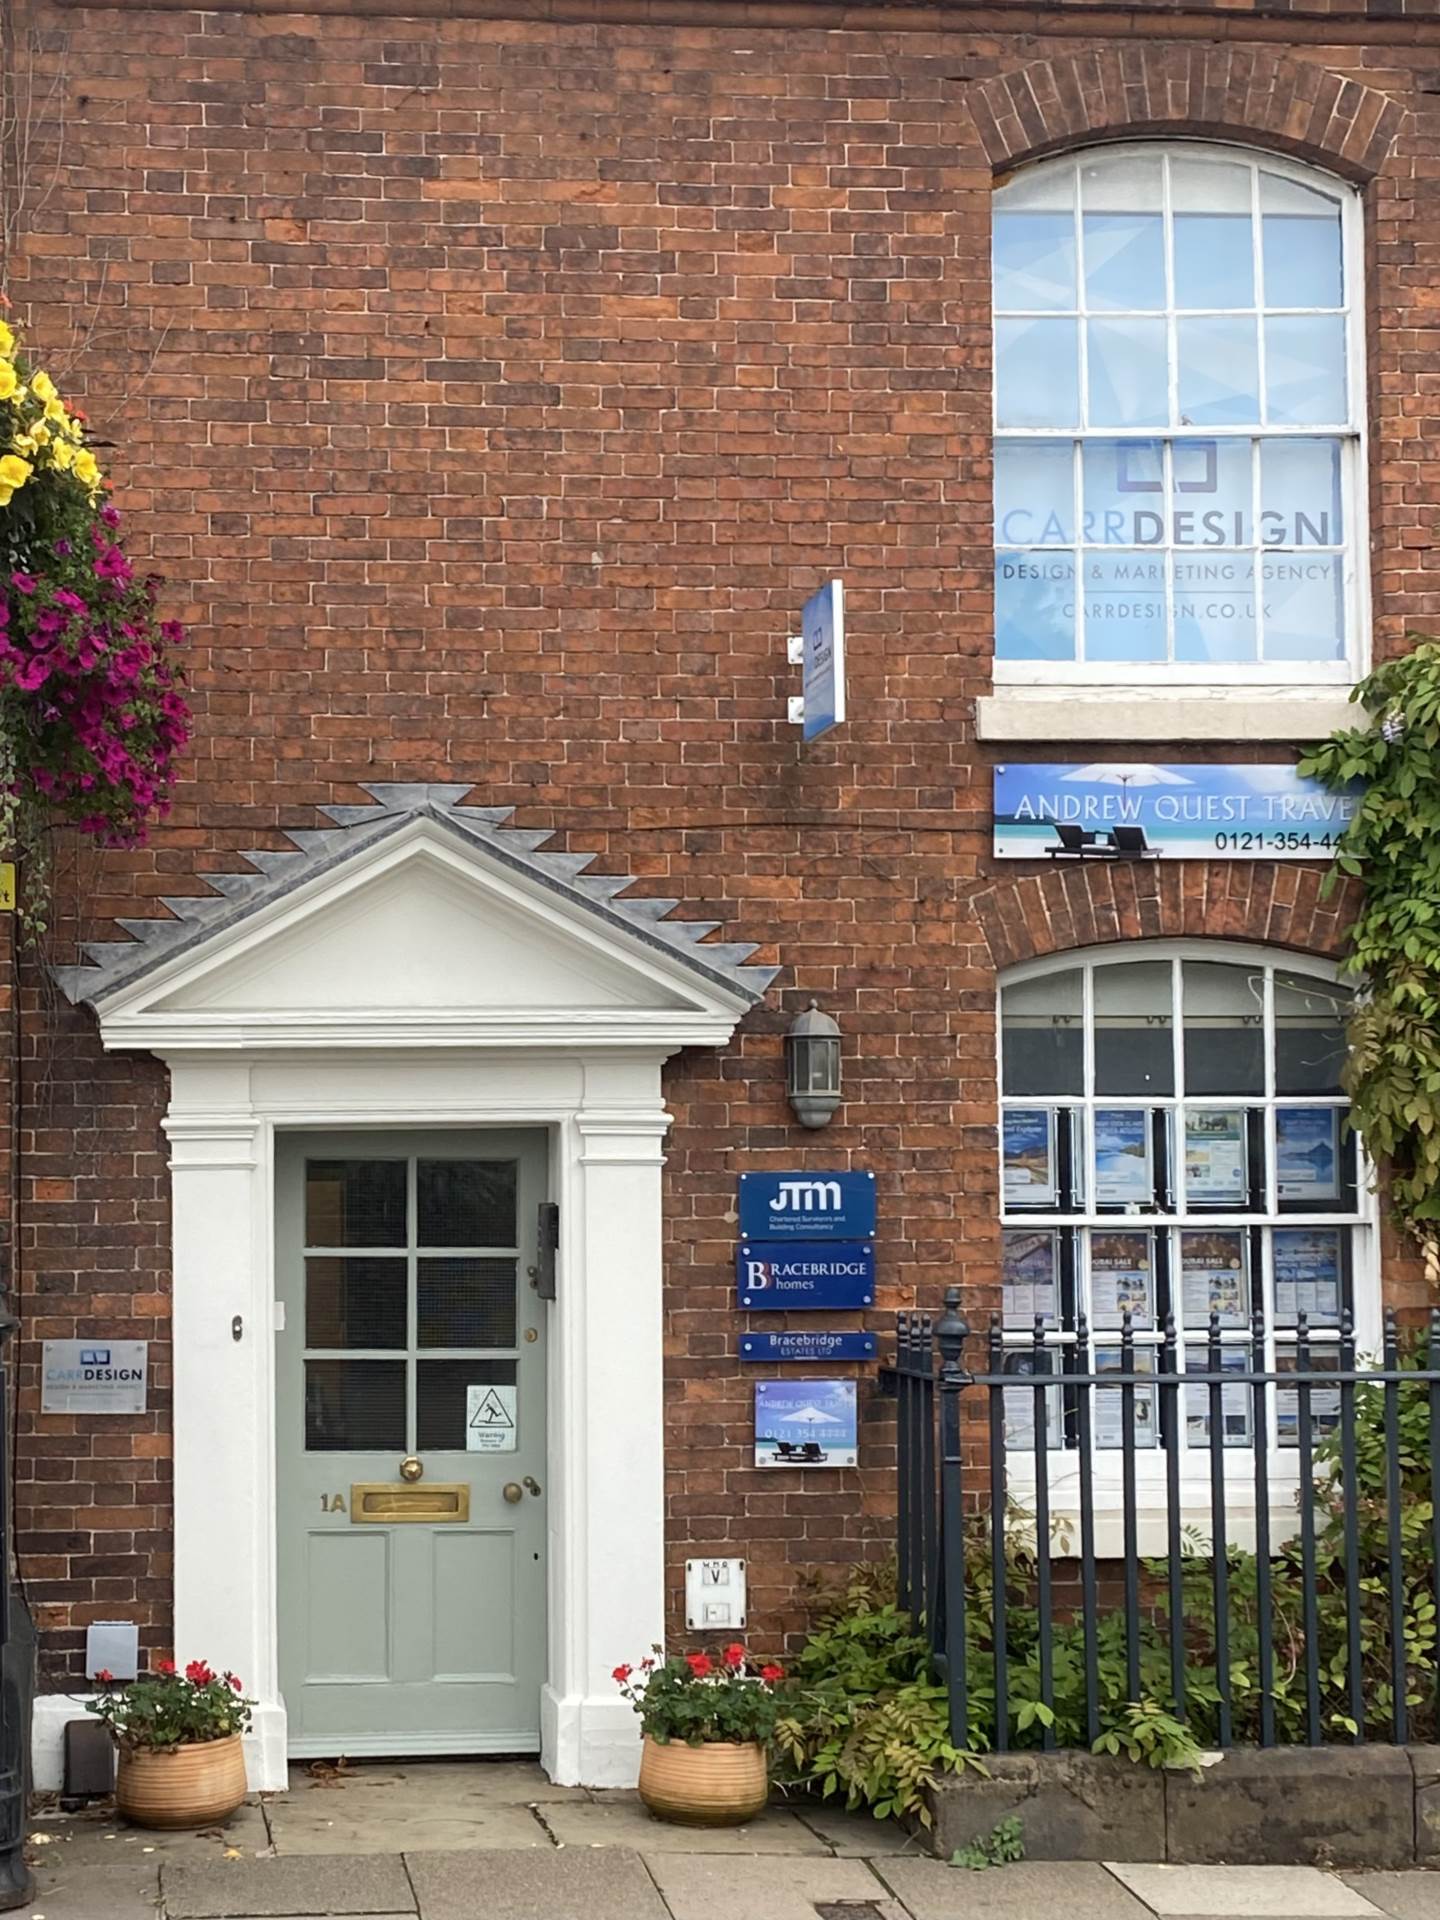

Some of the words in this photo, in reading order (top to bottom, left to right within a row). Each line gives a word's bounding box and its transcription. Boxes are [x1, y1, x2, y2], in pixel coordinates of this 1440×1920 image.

[1002, 509, 1330, 546] CARRDESIGN
[1091, 565, 1104, 579] &
[1014, 793, 1144, 822] ANDREW
[1154, 794, 1251, 823] QUEST
[1262, 794, 1354, 822] TRAVE
[746, 1261, 867, 1290] BRACEBRIDGE
[776, 1278, 814, 1290] homes
[769, 1334, 843, 1348] Bracebridge
[780, 1347, 815, 1356] ESTATES
[817, 1347, 832, 1356] LTD
[764, 1428, 792, 1439] 0121
[320, 1493, 347, 1513] 1A
[711, 1569, 720, 1584] V
